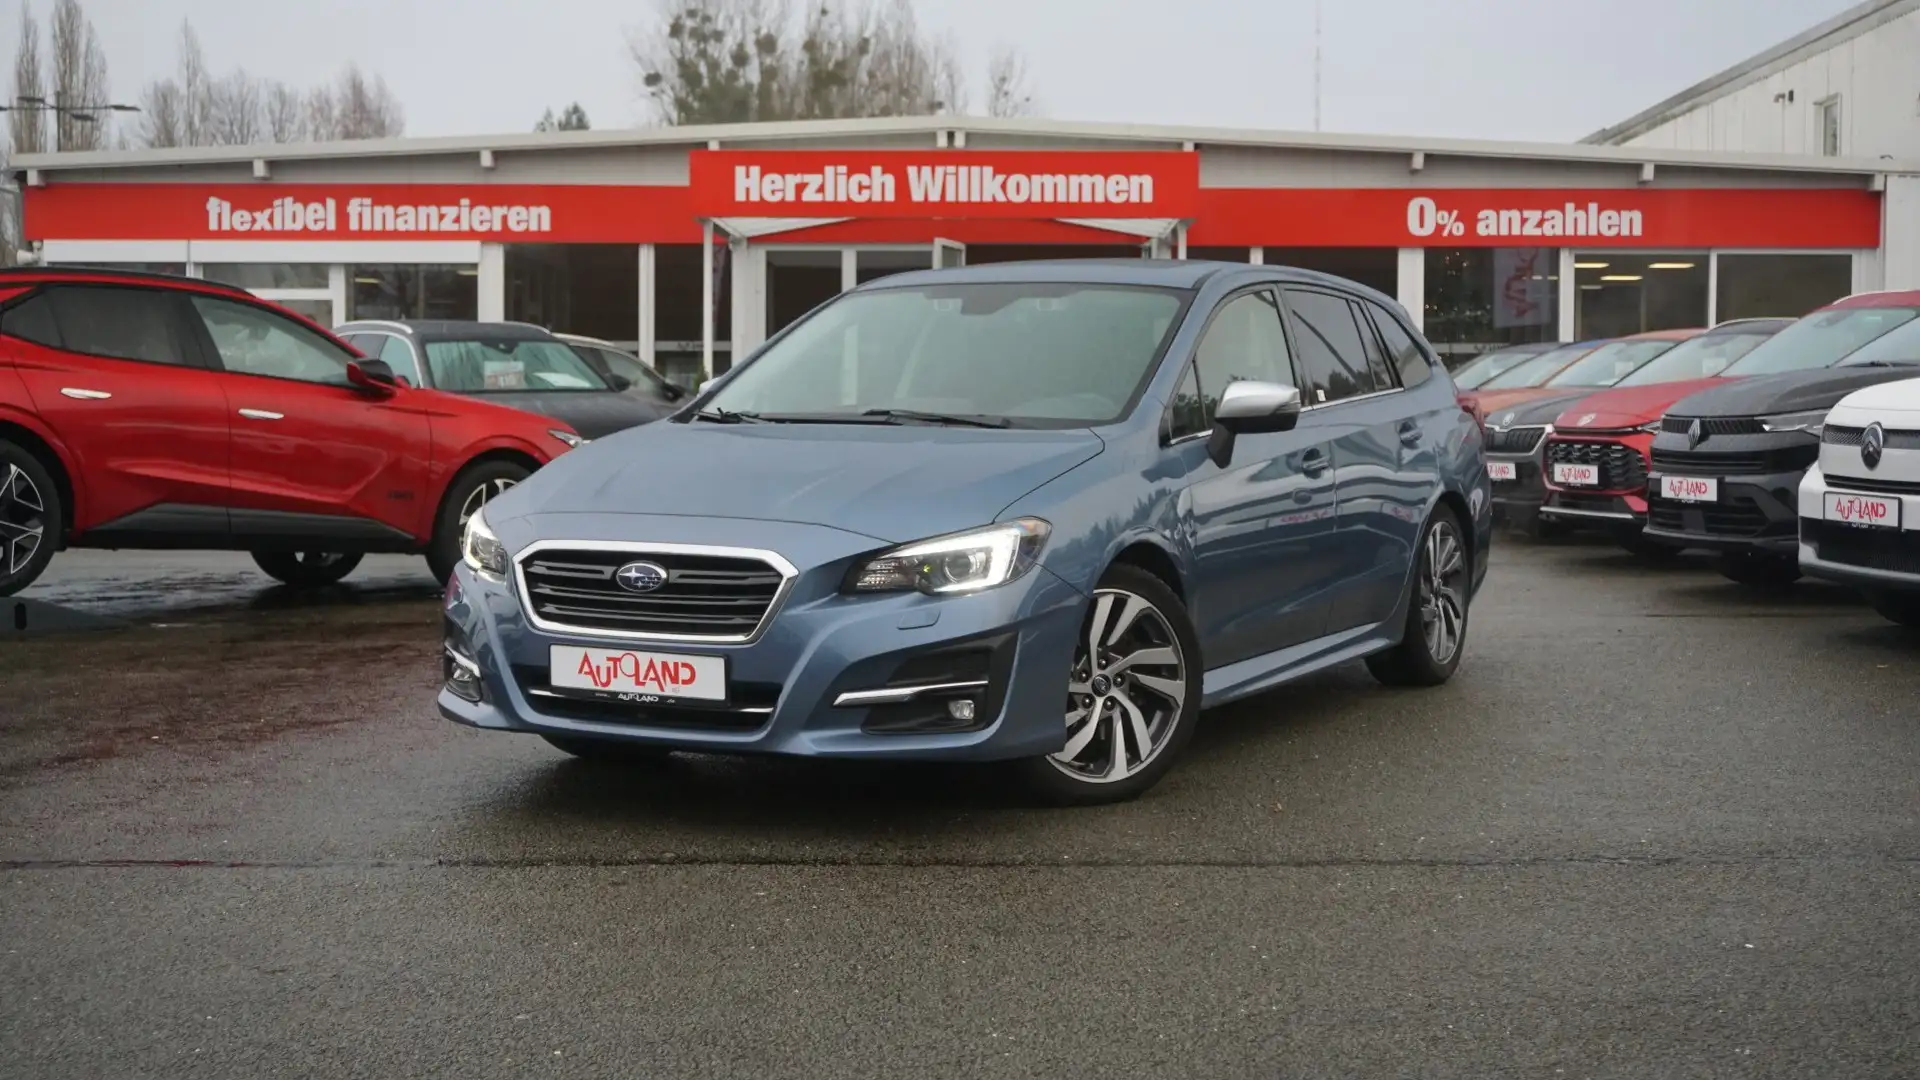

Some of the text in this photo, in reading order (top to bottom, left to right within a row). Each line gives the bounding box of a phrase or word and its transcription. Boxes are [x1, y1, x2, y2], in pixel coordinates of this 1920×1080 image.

[734, 165, 1153, 203] Herzlich Willkommen
[207, 196, 551, 232] flexibel finanzieren
[1407, 197, 1643, 237] 0% anzahlen
[1836, 497, 1886, 522] AUTOLAND
[578, 651, 697, 692] AUTOLAND
